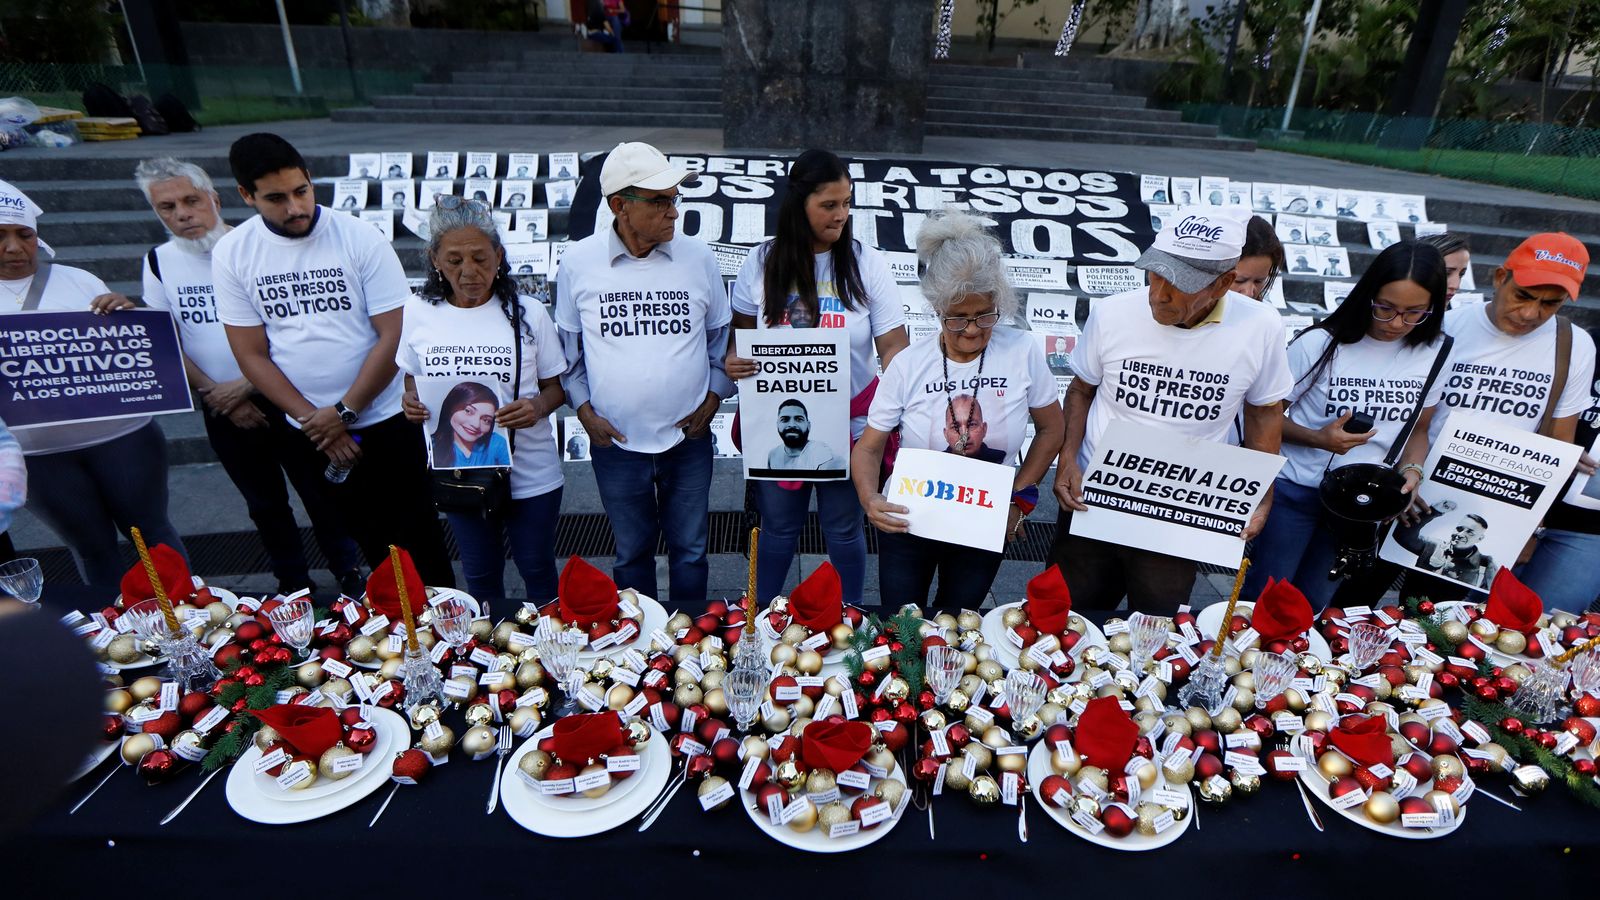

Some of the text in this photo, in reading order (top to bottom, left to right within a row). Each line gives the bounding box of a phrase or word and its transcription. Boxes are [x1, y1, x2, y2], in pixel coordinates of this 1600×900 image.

[884, 166, 919, 183] A
[930, 167, 1118, 193] TODOS
[256, 267, 343, 287] LIBEREN A TODOS
[258, 280, 347, 302] LOS PRESOS
[599, 290, 690, 304] LIBEREN A TODOS
[179, 296, 206, 308] LOS
[600, 302, 690, 319] LOS PRESOS
[1033, 308, 1054, 319] NO
[600, 317, 691, 337] POLÍTICOS
[0, 338, 153, 358] LIBERTAD A LOS
[426, 345, 512, 355] LIBEREN A TODOS
[752, 346, 833, 355] LIBERTAD PARA
[0, 351, 153, 377] CAUTIVOS
[425, 356, 512, 367] LOS PRESOS
[8, 370, 156, 389] Y PONER EN LIBERTAD
[1122, 359, 1230, 385] LIBEREN A TODOS
[1498, 368, 1507, 377] A
[1511, 369, 1551, 384] TODOS
[756, 379, 838, 393] BABUEL
[925, 375, 1008, 394] LUIS LÓPEZ
[1119, 371, 1226, 402] LOS PRESOS
[1329, 377, 1423, 389] LIBEREN A TODOS
[1477, 378, 1547, 400] PRESOS
[12, 391, 25, 401] A
[29, 388, 60, 400] LOS
[120, 395, 145, 403] Lucas
[1115, 387, 1221, 421] POLÍTICOS
[1328, 389, 1421, 404] LOS PRESOS
[1453, 429, 1561, 467] LIBERTAD PARA
[1447, 442, 1553, 480] ROBERT FRANCO
[1103, 449, 1261, 497] LIBEREN A LOS
[1447, 462, 1530, 492] EDUCADOR Y
[898, 477, 994, 509] NOBEL
[1087, 469, 1252, 516] ADOLESCENTES
[1435, 468, 1533, 504] LÍDER SINDICAL
[1084, 490, 1243, 534] INJUSTAMENTE DETENIDOS
